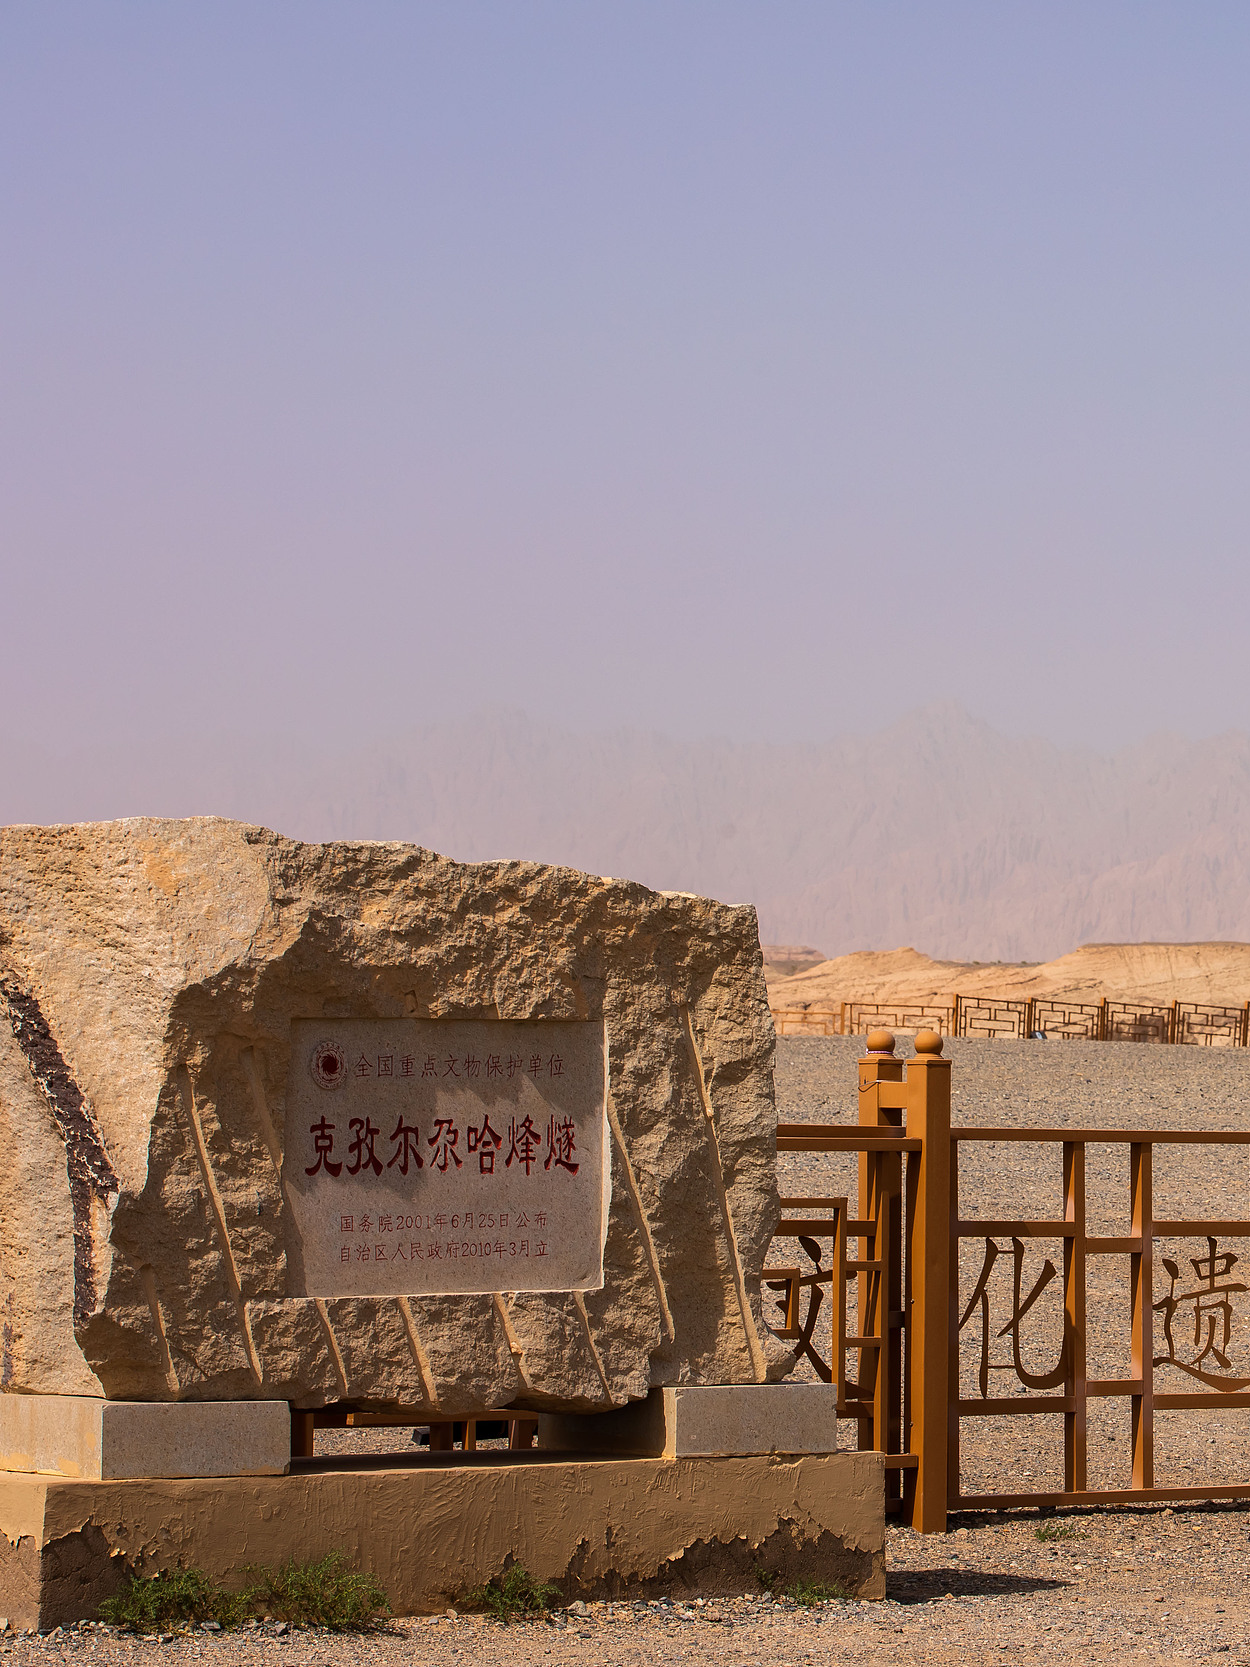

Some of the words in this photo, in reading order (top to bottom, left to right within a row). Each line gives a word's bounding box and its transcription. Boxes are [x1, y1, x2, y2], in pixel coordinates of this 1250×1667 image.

[353, 1053, 566, 1078] 全国重点文物保护单位
[304, 1114, 580, 1178] 克孜尔尕哈烽燧
[339, 1211, 548, 1234] 国务院2001年6月25日公布
[339, 1239, 550, 1263] 自治区人民政府2010年3月立
